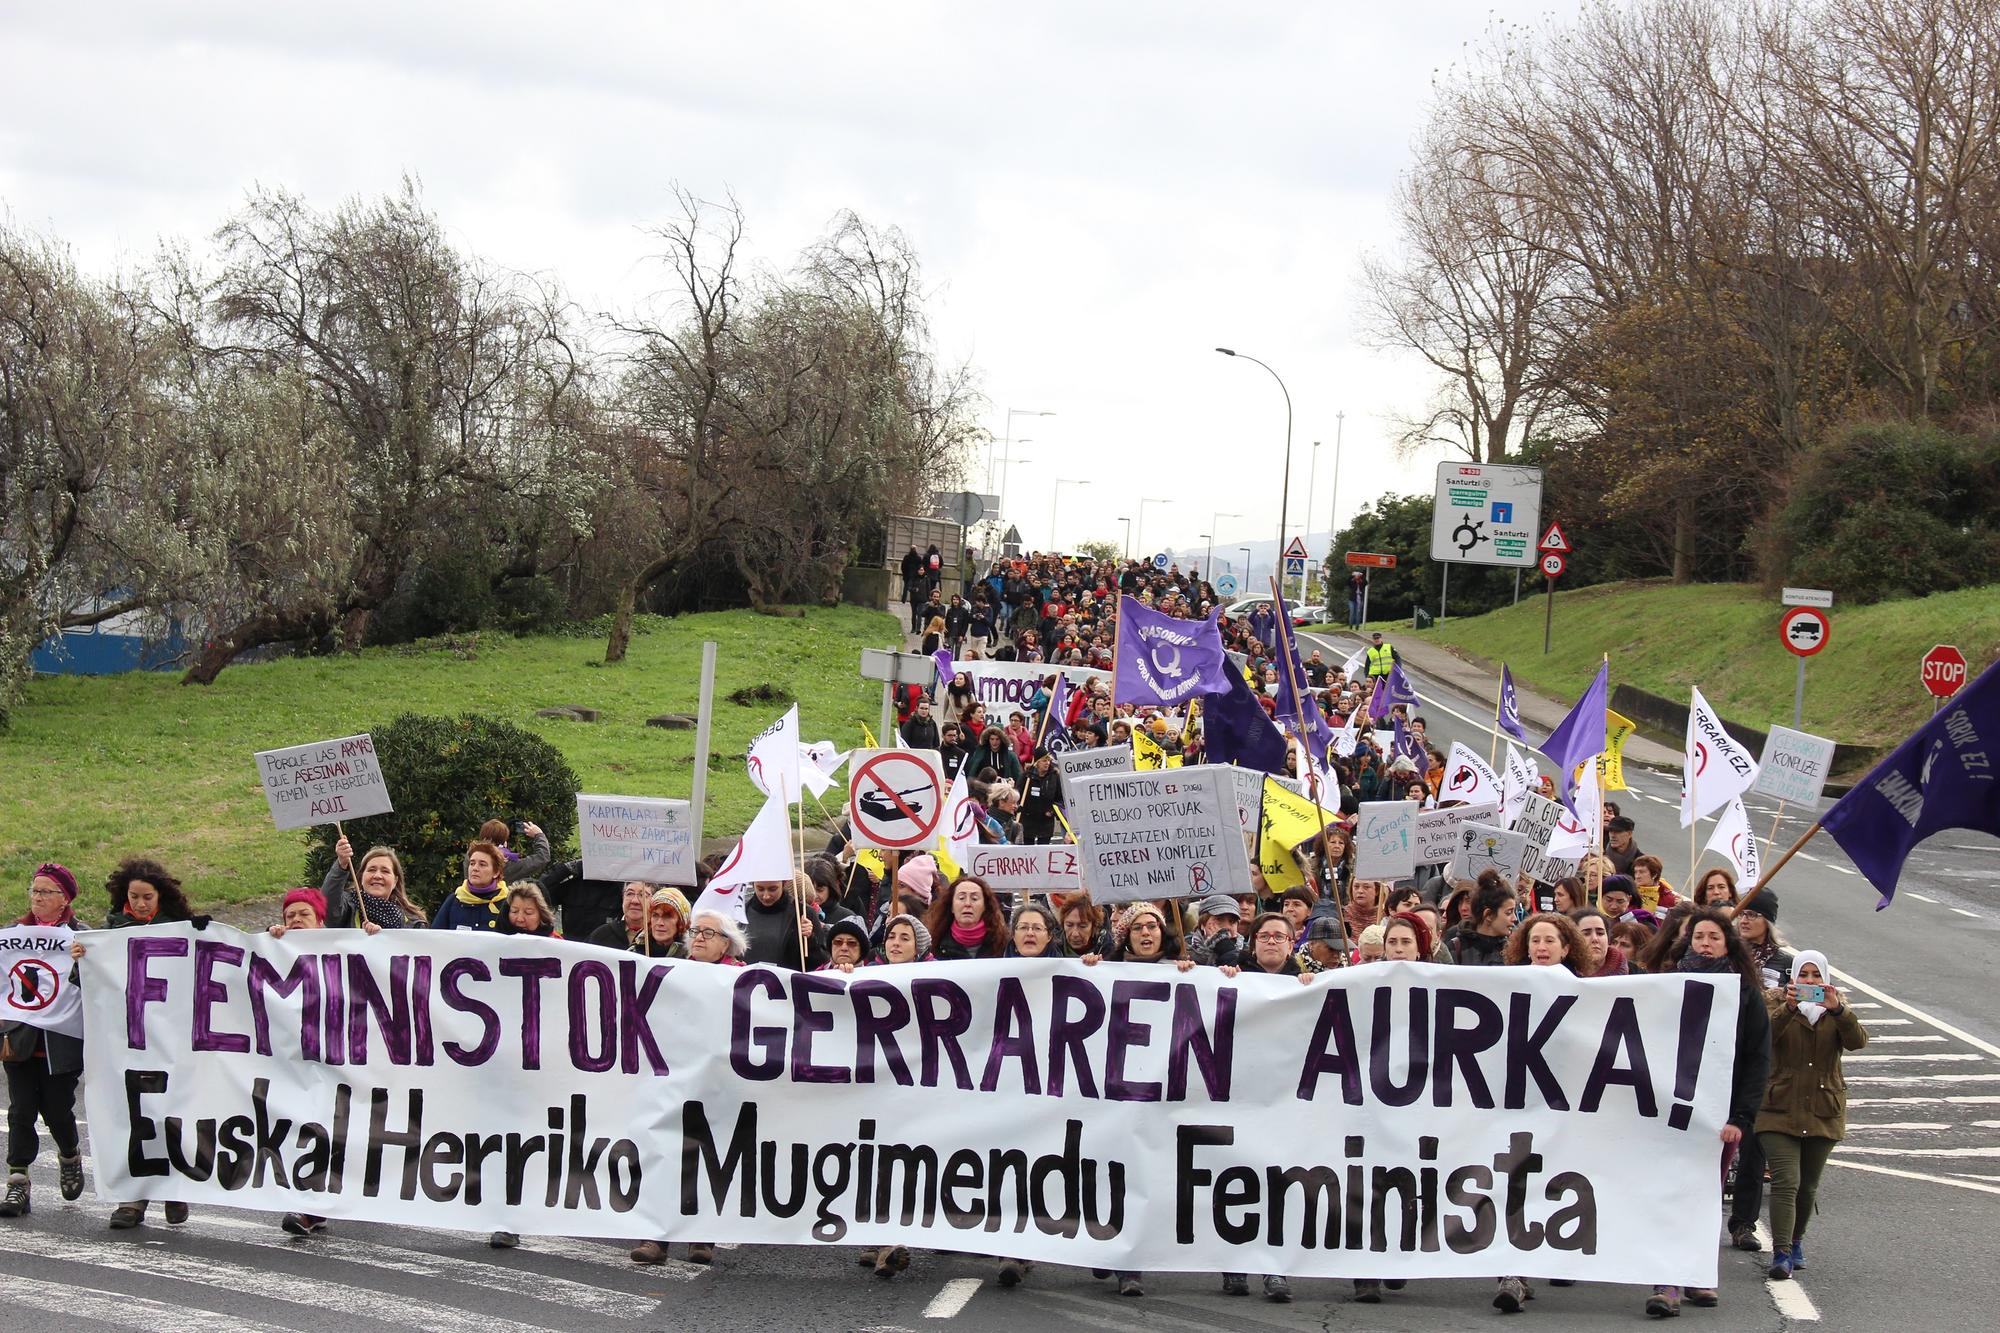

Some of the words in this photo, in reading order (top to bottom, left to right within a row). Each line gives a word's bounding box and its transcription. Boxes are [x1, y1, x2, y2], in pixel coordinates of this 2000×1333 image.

[1446, 478, 1480, 487] Santurtzi
[1494, 529, 1529, 538] Santurtzi
[1547, 560, 1559, 569] 30
[1924, 661, 1964, 682] STOP
[264, 754, 307, 771] PORQUE
[316, 749, 336, 763] LAS
[341, 738, 373, 758] ARMAS
[1064, 761, 1093, 774] GUDAK
[1095, 756, 1126, 769] BILBOKO
[268, 773, 289, 788] QUE
[294, 760, 350, 784] ASESINAN
[353, 758, 368, 773] EN
[1729, 755, 1752, 777] EZ!
[272, 785, 308, 803] YEMEN
[313, 783, 327, 796] SE
[328, 771, 380, 792] FABRICAN
[1089, 781, 1160, 801] FEMINISTOK
[1165, 784, 1178, 795] EZ
[311, 795, 348, 817] AQUI
[588, 804, 658, 821] KAPITALARI
[1091, 806, 1142, 824] BILBOKO
[1147, 802, 1203, 819] PORTUAK
[1525, 795, 1537, 815] LA
[592, 823, 639, 841] MUGAK
[1094, 828, 1170, 846] BULTZATZEN
[1177, 825, 1215, 839] DITUEN
[642, 847, 681, 864] IXTEN
[974, 853, 1040, 877] GERRARIK
[1048, 851, 1077, 875] EZ
[1099, 849, 1150, 867] GERREN
[1157, 843, 1217, 861] KONPLIZE
[1110, 872, 1139, 888] IZAN
[126, 937, 674, 1076] FEMINISTOK
[729, 968, 1238, 1101] GERRAREN
[1296, 980, 1715, 1130] AURKA!
[124, 1069, 352, 1195] Euskal
[363, 1087, 642, 1213] Herriko
[680, 1101, 1125, 1242] Mugimendu
[1176, 1125, 1597, 1256] Feminista
